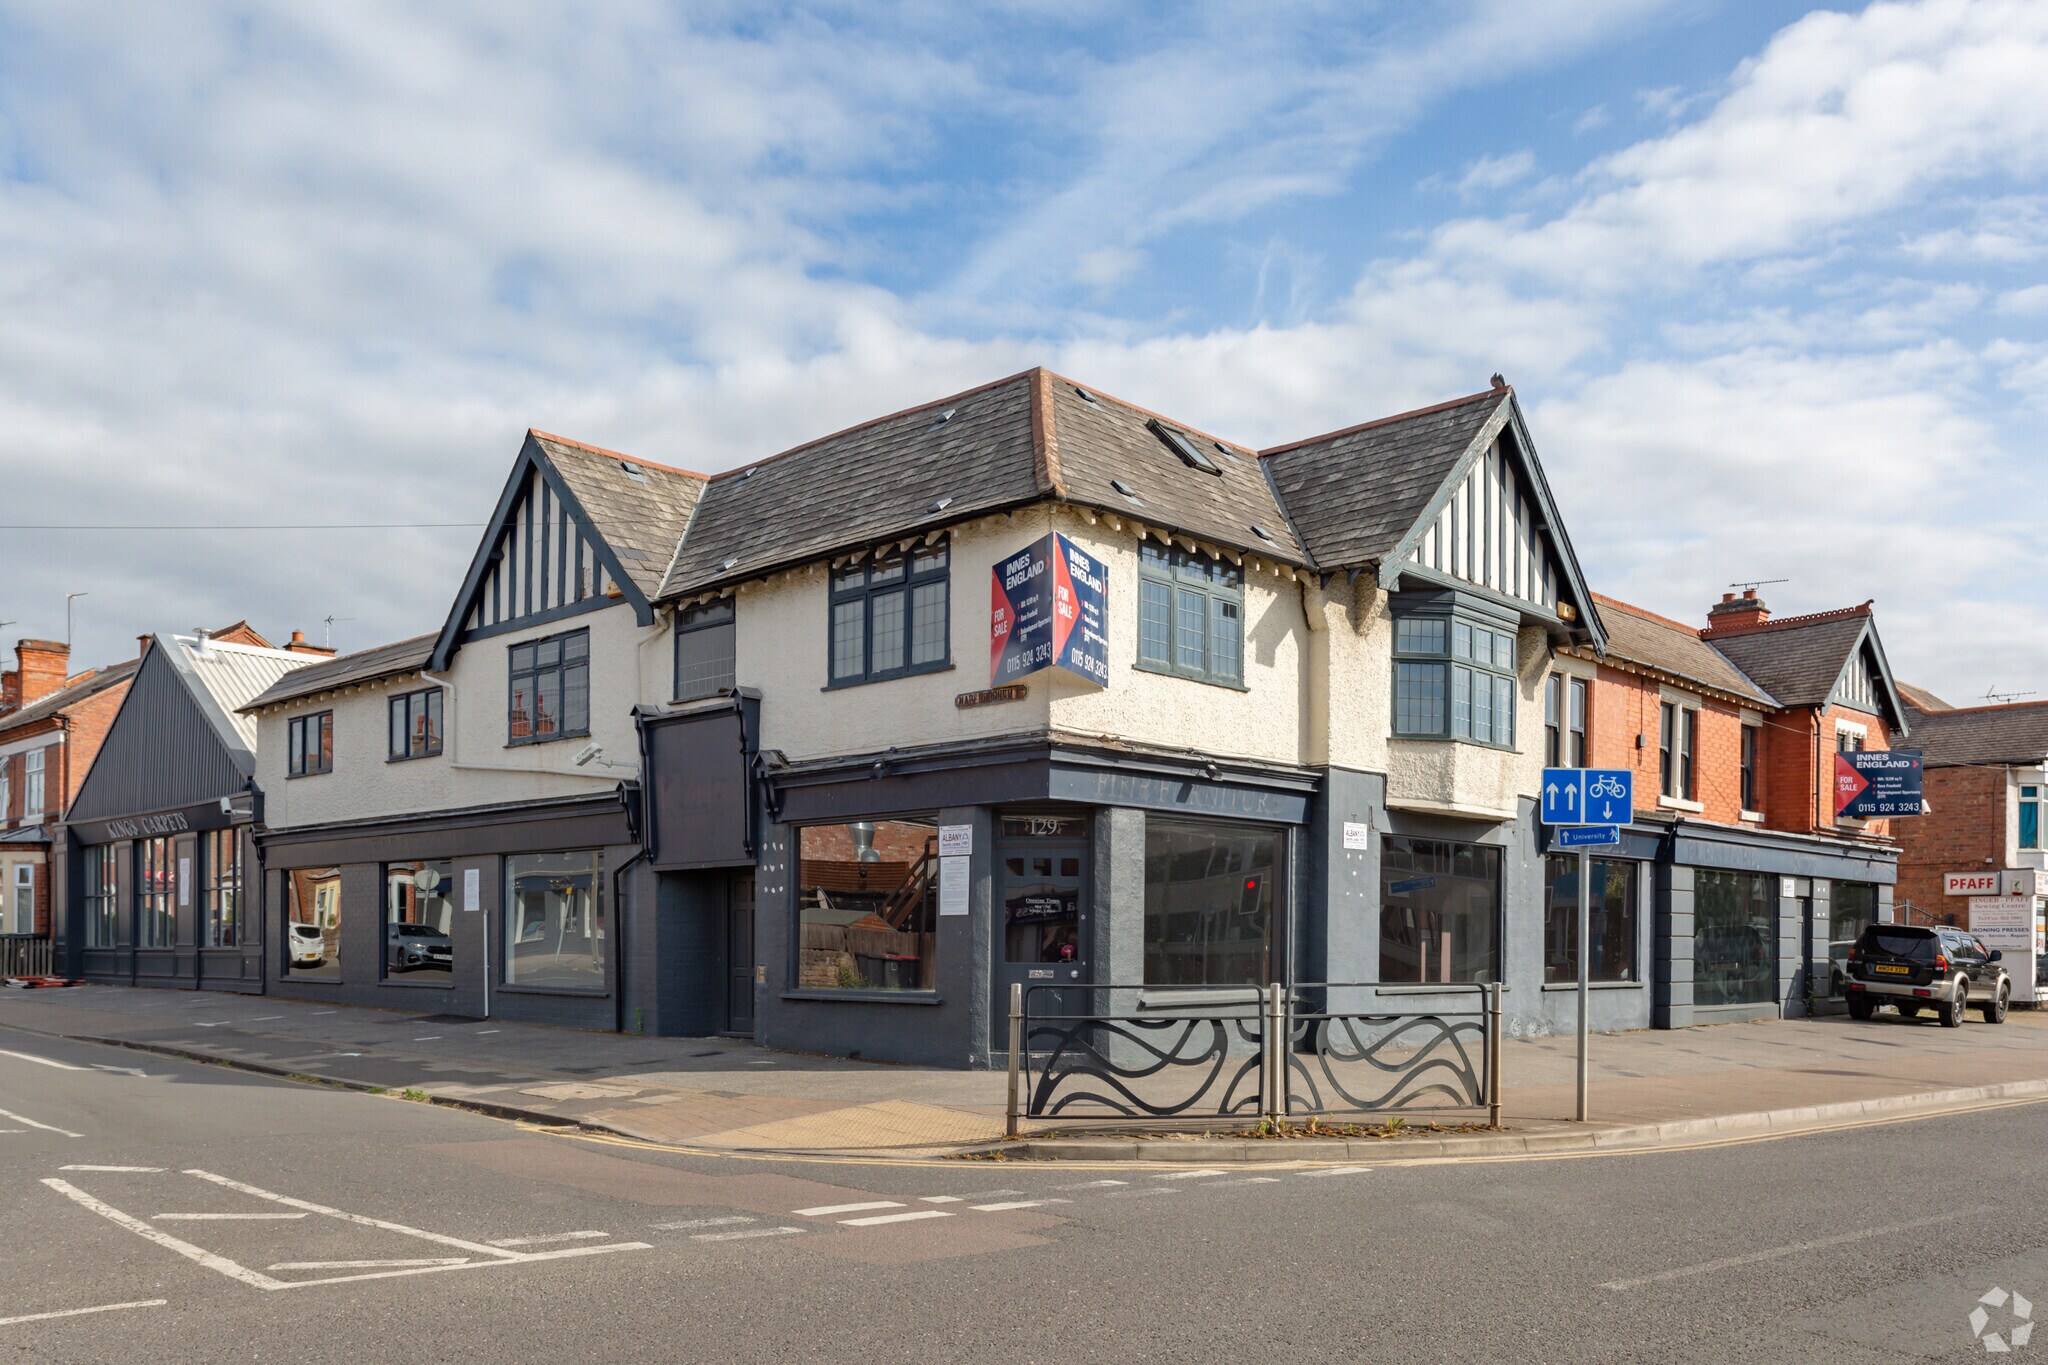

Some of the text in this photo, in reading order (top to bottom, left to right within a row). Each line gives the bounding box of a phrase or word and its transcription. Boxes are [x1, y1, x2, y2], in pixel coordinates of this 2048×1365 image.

[1006, 553, 1030, 573] INNES
[1070, 548, 1090, 571] INNES
[1006, 560, 1044, 590] ENGLAND
[1070, 562, 1102, 593] ENGLAND
[1058, 586, 1069, 602] FOR
[994, 609, 1004, 620] FOR
[1058, 602, 1073, 619] SALE
[994, 623, 1008, 637] SALE
[1007, 642, 1051, 674] 0115 924 3243
[1071, 647, 1108, 680] 0115 924 3243
[1840, 776, 1853, 784] FOR
[1858, 802, 1920, 812] 0115 924 3243
[106, 812, 189, 838] KINGS CARPETS
[1030, 819, 1057, 835] 129
[943, 833, 962, 841] ALBANY
[1572, 833, 1606, 841] University
[1950, 878, 1994, 889] PFAFF
